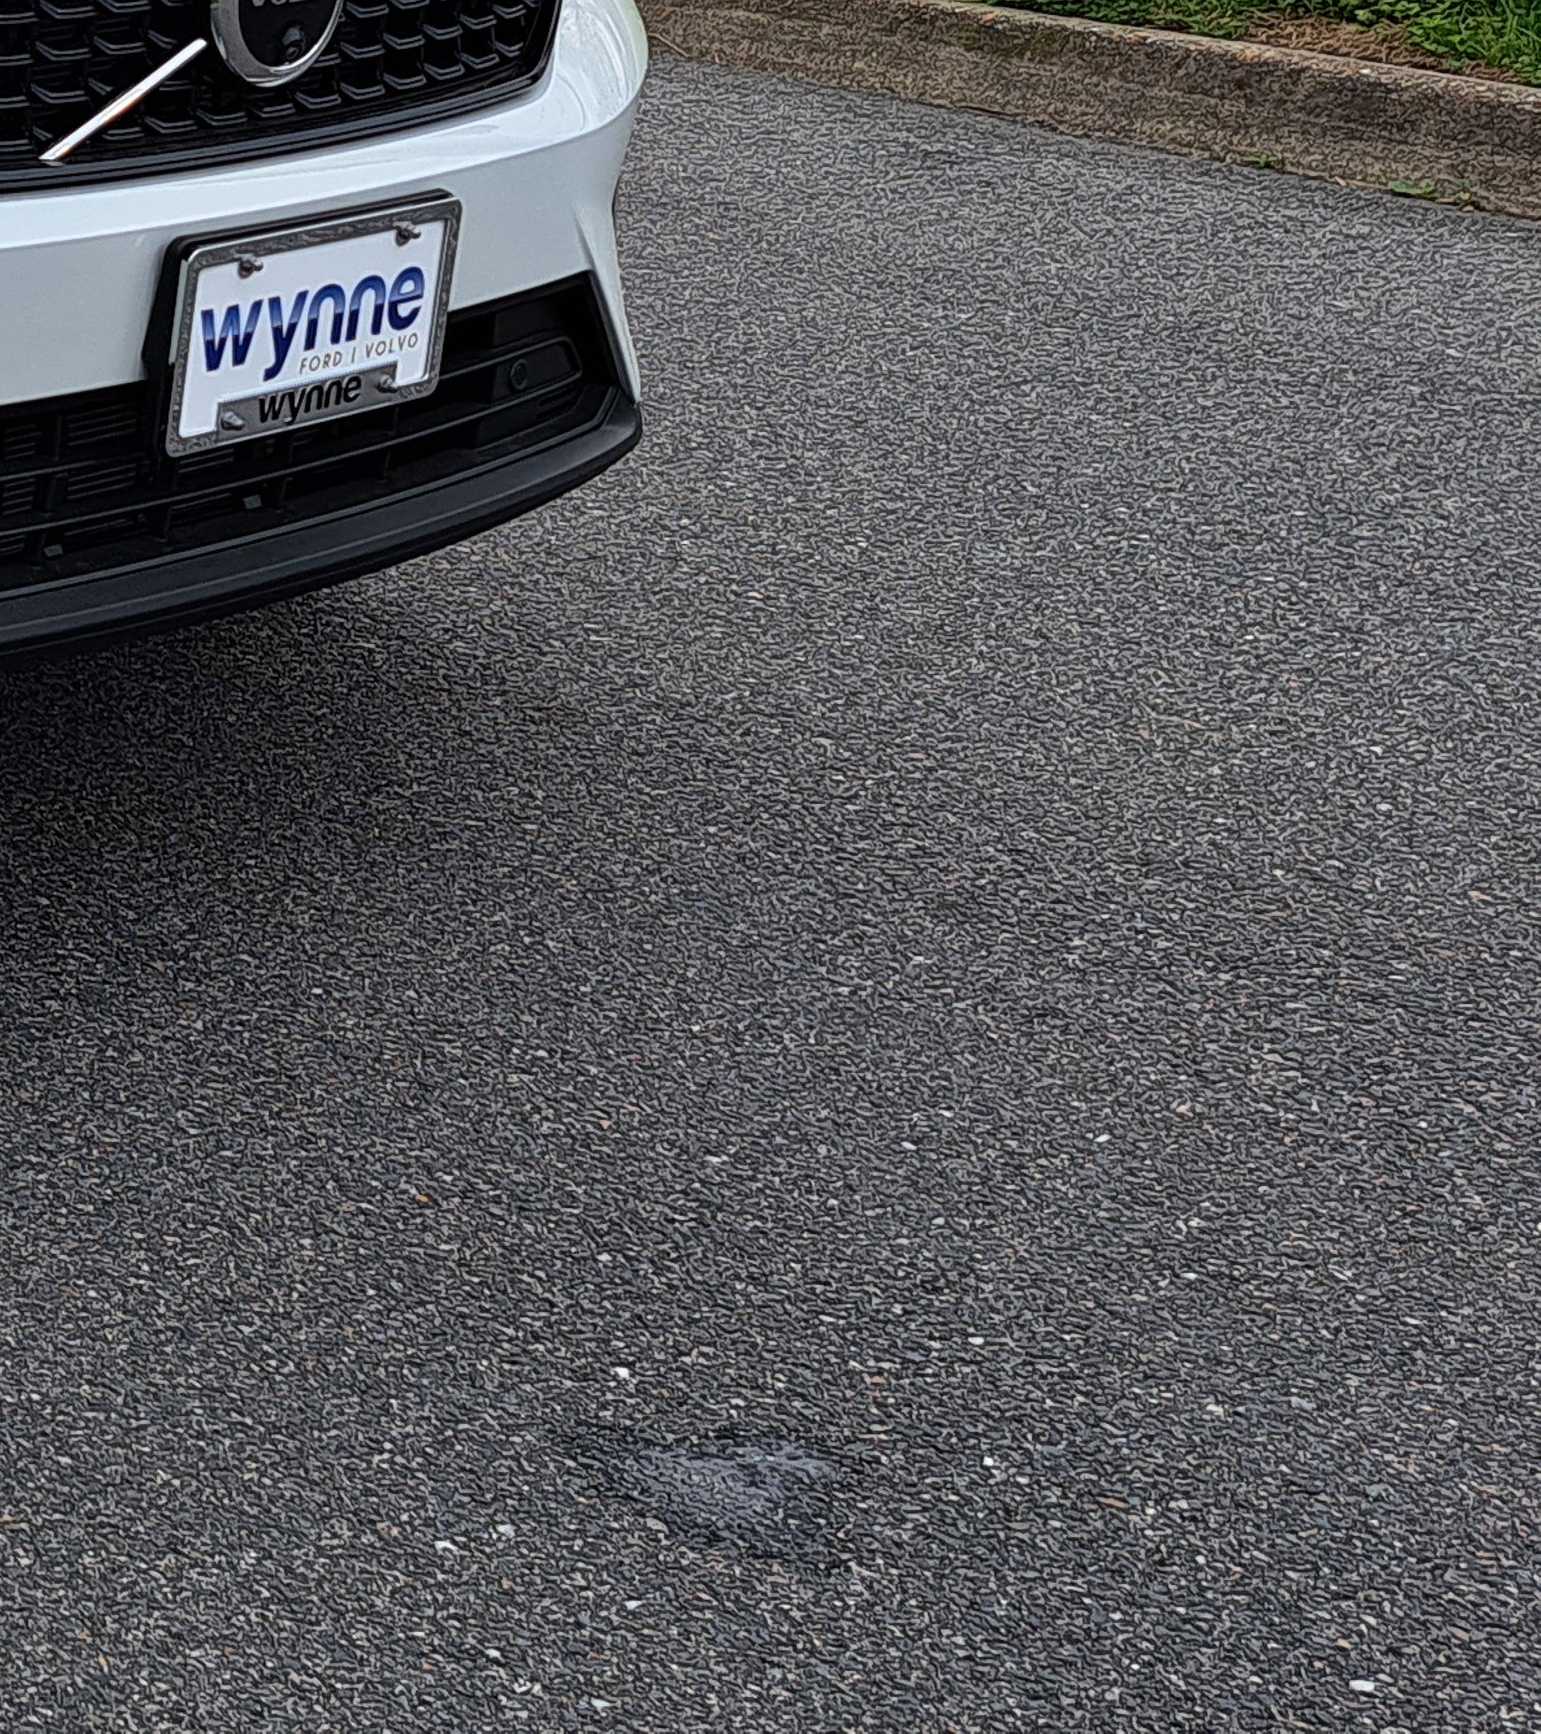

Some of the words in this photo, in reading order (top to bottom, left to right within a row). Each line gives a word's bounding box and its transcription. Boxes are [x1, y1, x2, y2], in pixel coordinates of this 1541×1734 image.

[200, 265, 426, 382] wynne
[299, 350, 343, 375] FORD
[365, 332, 419, 358] VOLVO
[257, 375, 362, 425] wynne
